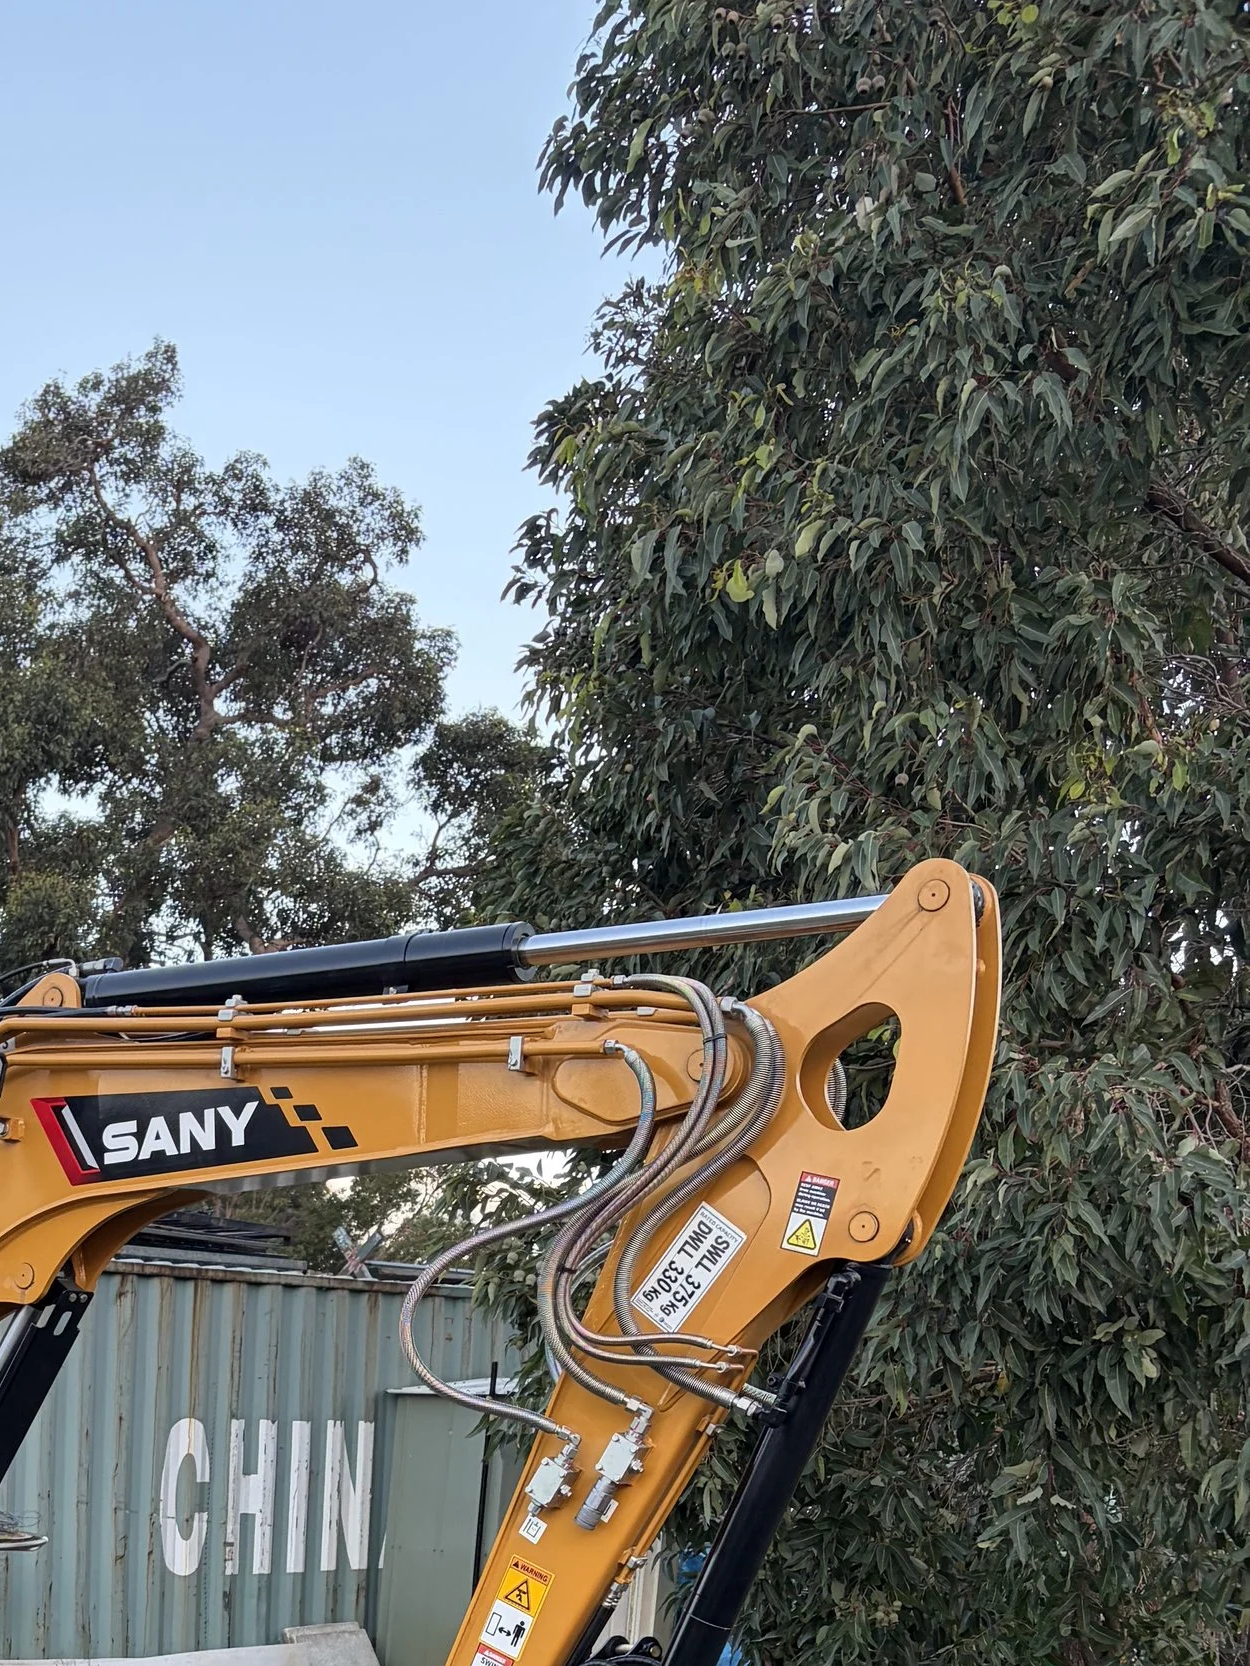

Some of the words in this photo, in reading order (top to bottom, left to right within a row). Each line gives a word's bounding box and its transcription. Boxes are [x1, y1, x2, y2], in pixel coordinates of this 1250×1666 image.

[102, 1101, 259, 1165] SANY
[677, 1219, 713, 1259] DWLL
[700, 1211, 717, 1227] RATED
[715, 1221, 739, 1244] CAPACITY
[694, 1235, 731, 1273] SWLL
[160, 1417, 387, 1577] CHIN
[520, 1563, 548, 1583] WARNING
